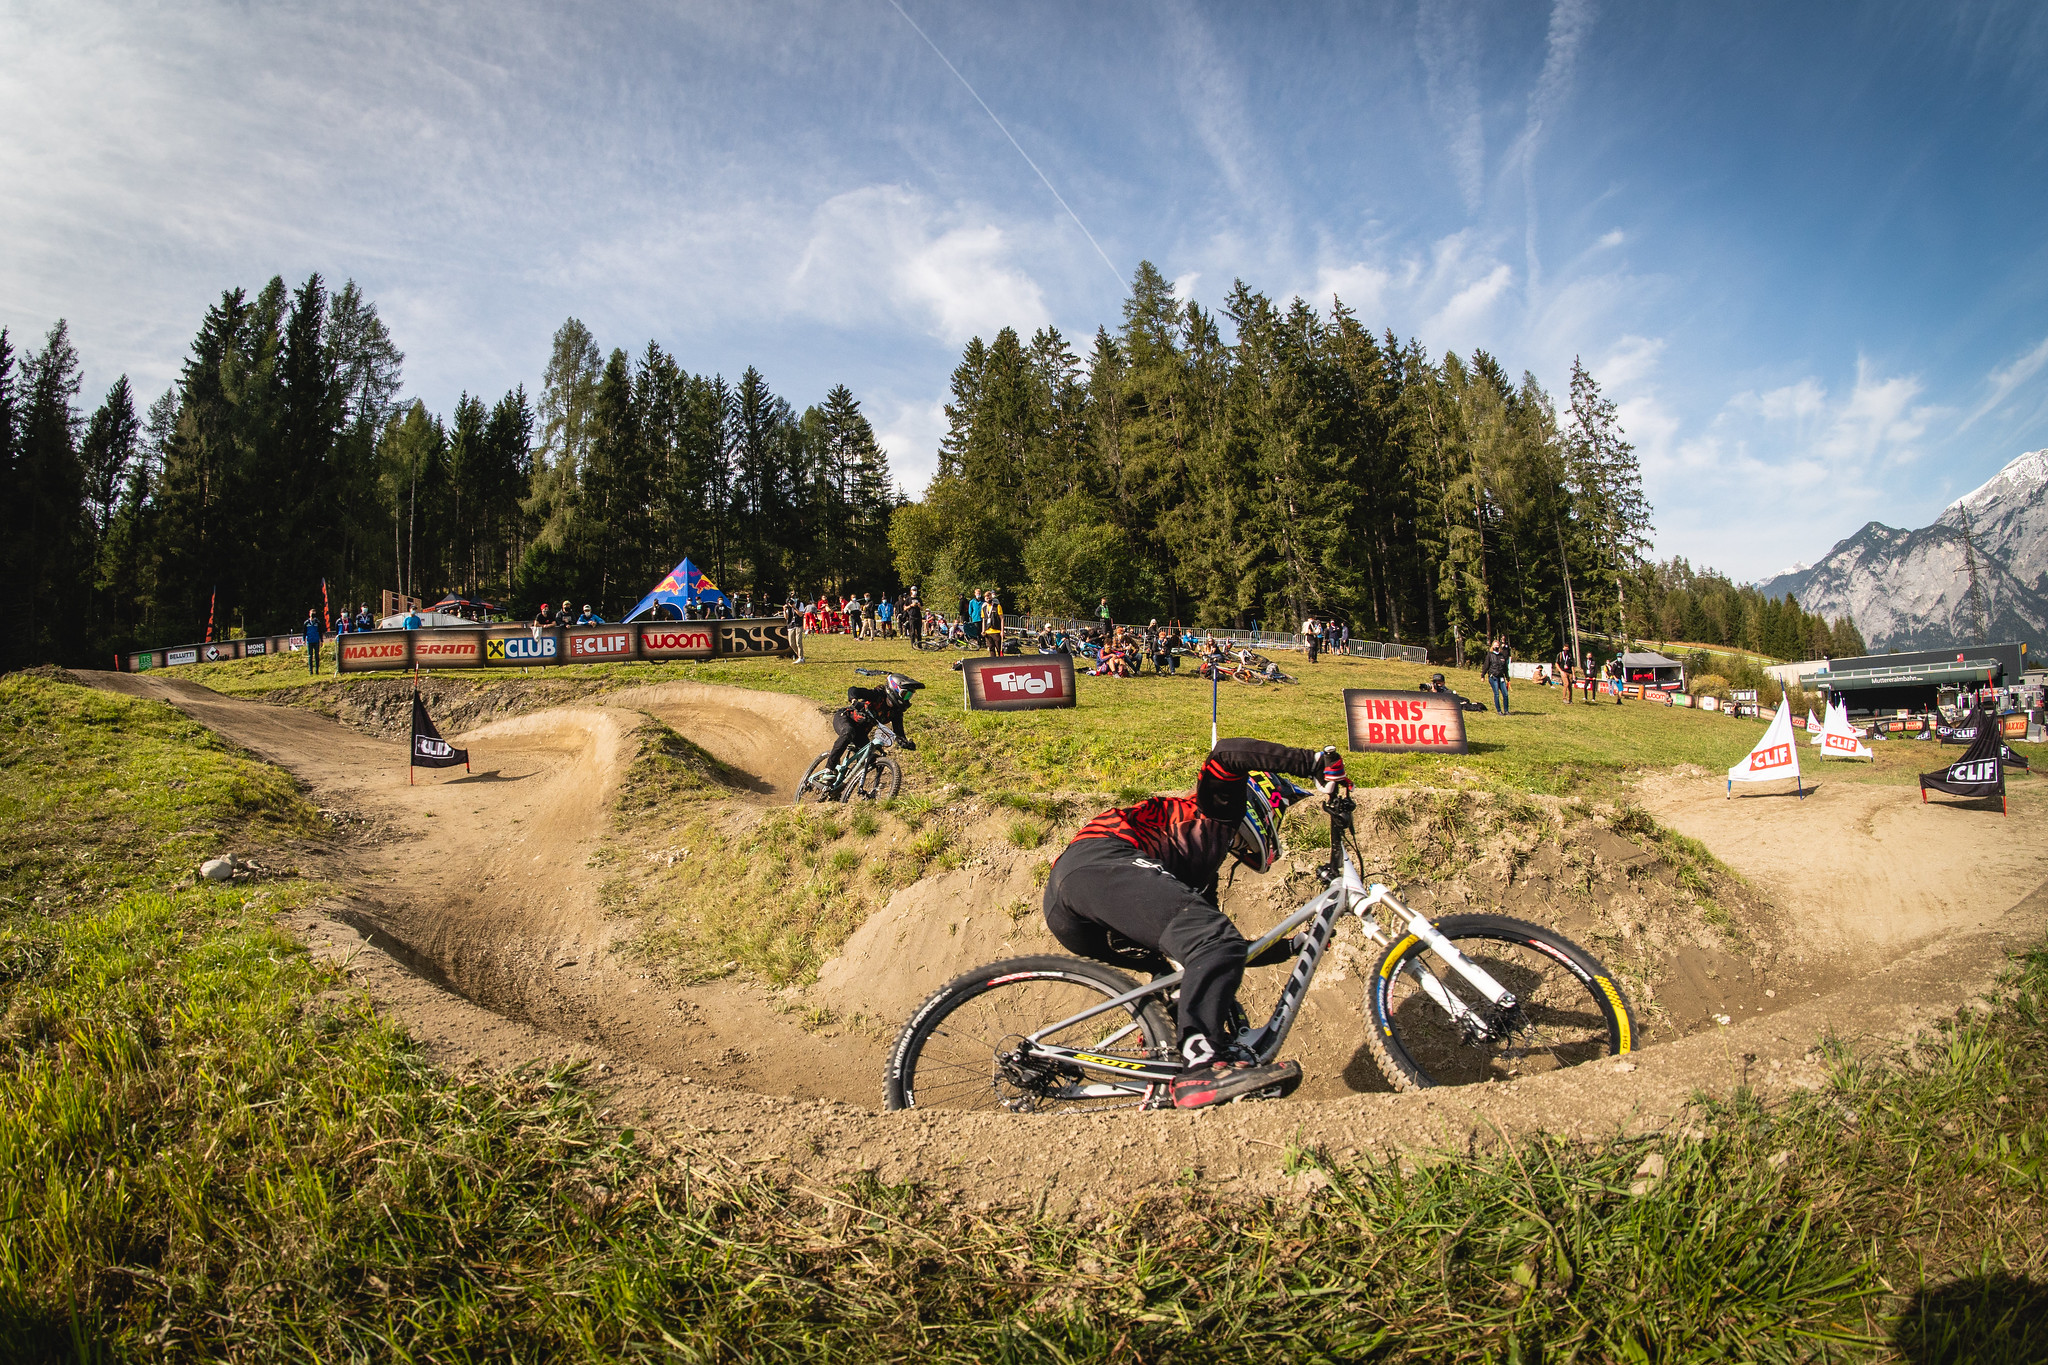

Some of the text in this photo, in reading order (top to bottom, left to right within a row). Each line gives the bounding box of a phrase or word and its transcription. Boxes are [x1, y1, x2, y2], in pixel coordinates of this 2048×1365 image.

[343, 644, 403, 659] MAXXIS
[415, 643, 476, 655] SRAM
[583, 636, 626, 653] CLIF
[992, 670, 1054, 694] Tirol
[1365, 699, 1427, 721] INNS'
[1368, 722, 1449, 745] BRUCK
[1955, 729, 1976, 738] CLIF
[1829, 736, 1856, 750] CLIF
[1754, 746, 1788, 768] CLIF
[1953, 761, 1995, 781] CLIF
[1073, 1053, 1147, 1071] SCOTT
